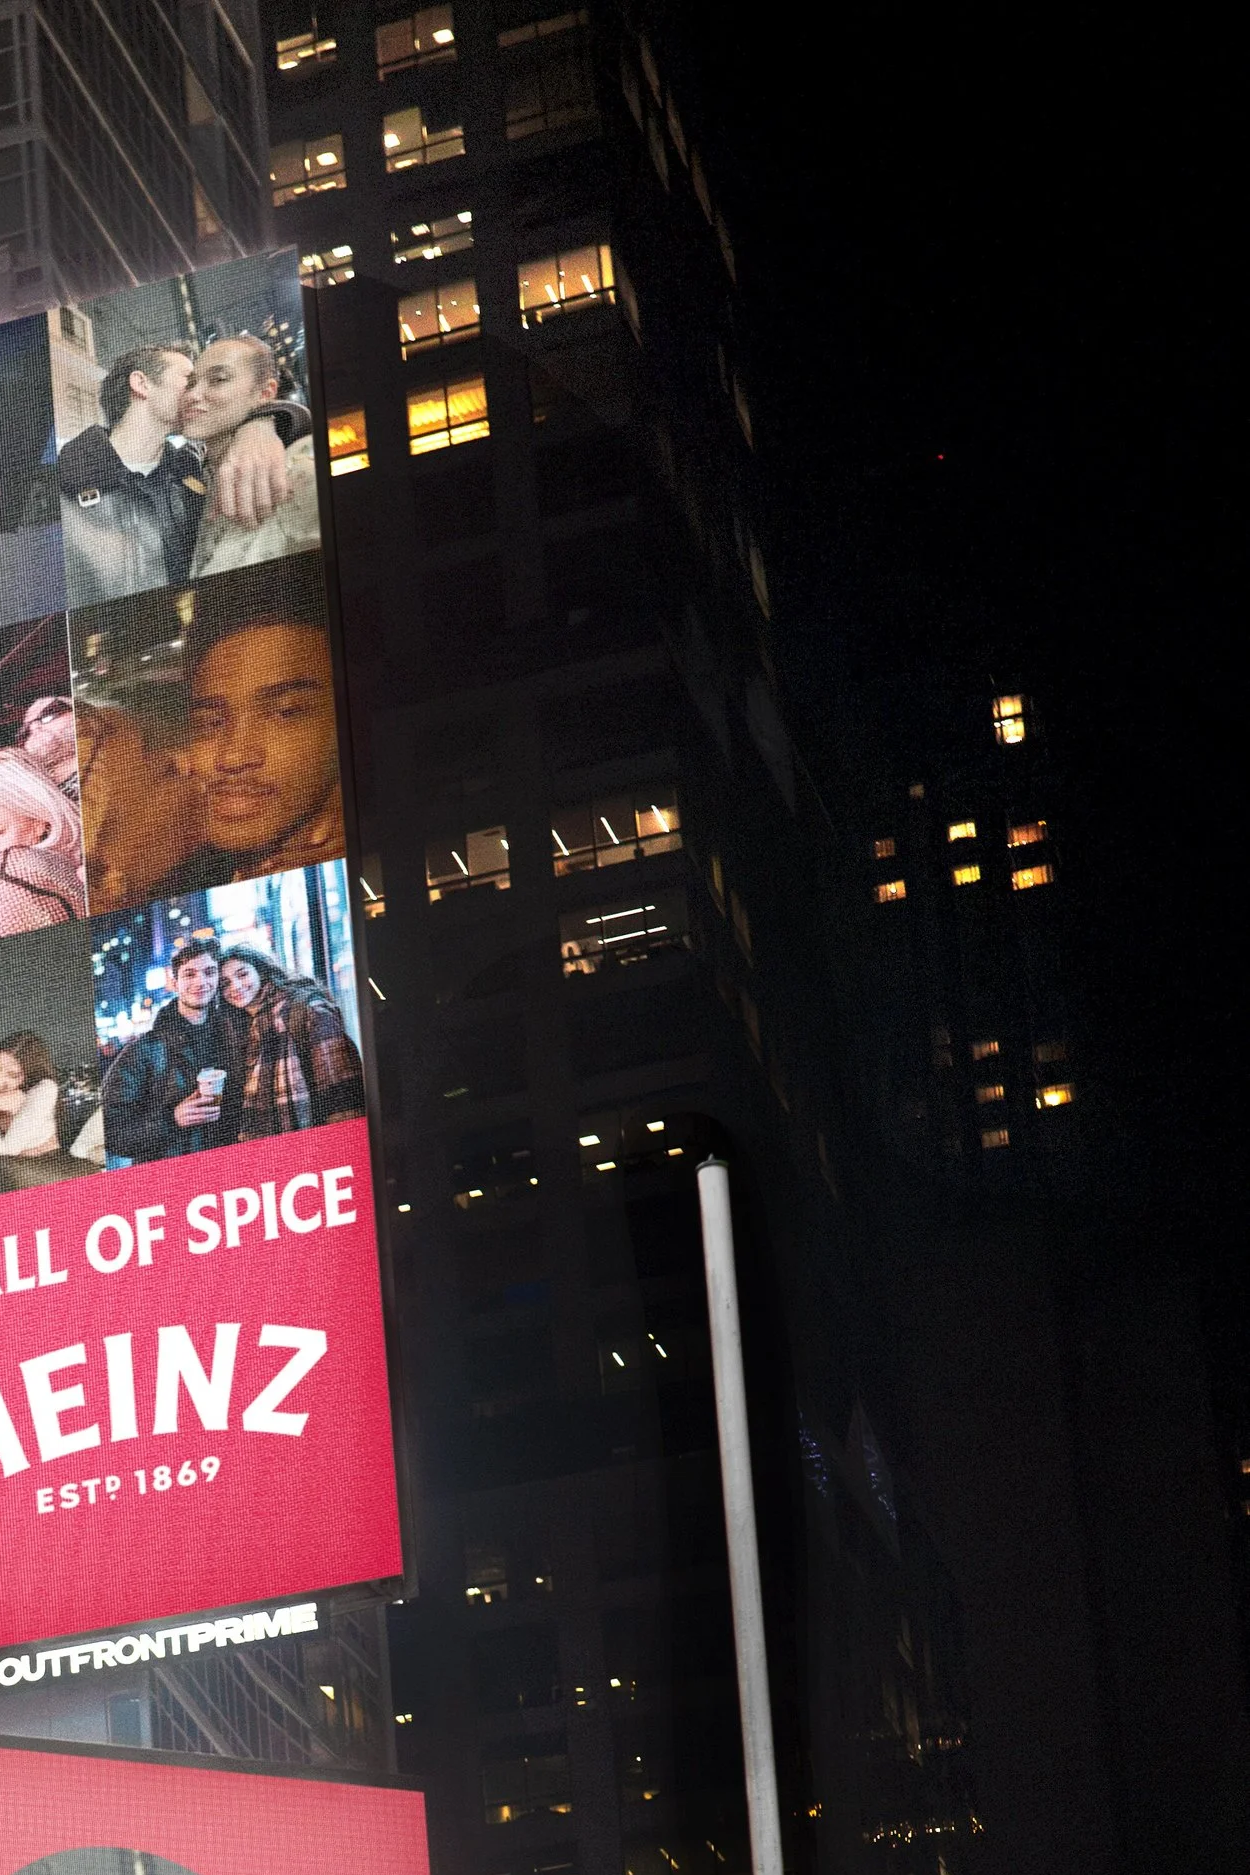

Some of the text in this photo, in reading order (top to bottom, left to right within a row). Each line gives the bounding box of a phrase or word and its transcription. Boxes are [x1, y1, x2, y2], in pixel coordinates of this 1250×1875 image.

[84, 1204, 166, 1275] OF
[184, 1165, 358, 1255] SPICE
[134, 1456, 222, 1495] 1869
